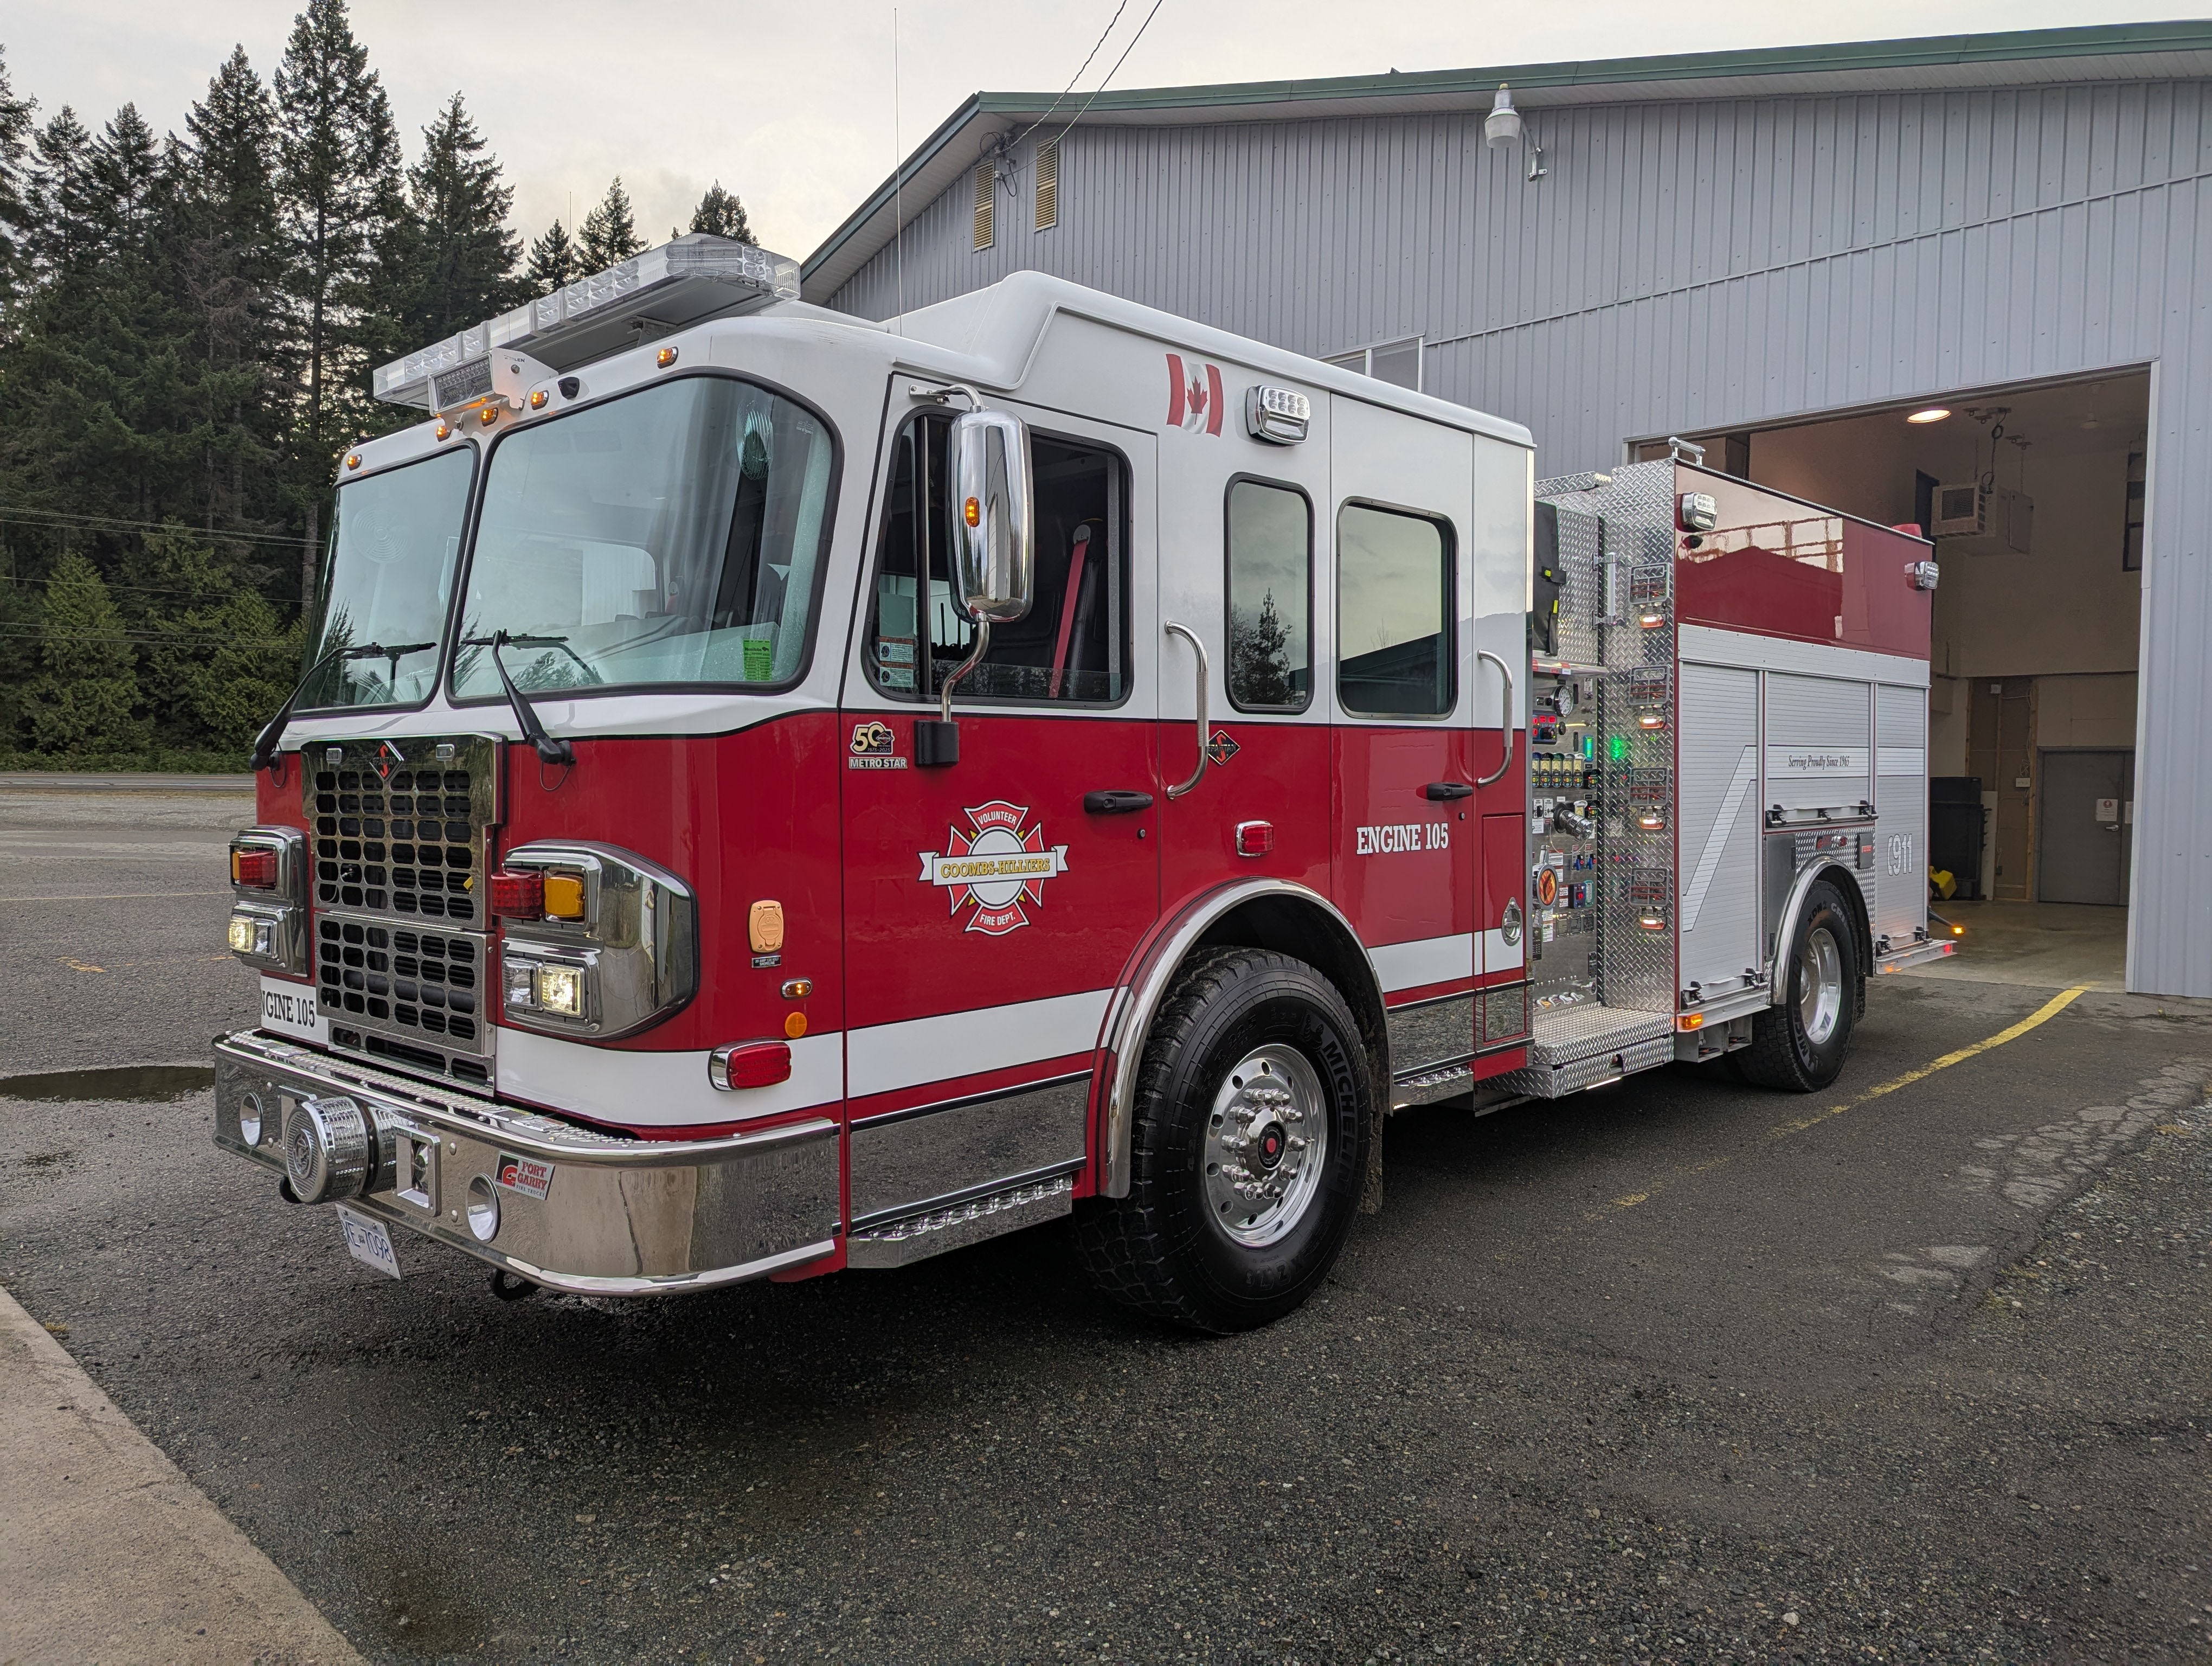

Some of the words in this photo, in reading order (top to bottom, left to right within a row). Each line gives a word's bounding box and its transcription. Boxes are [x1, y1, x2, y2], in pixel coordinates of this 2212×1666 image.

[850, 759, 882, 768] METRO
[883, 759, 906, 768] STAR
[1789, 755, 1806, 770] Serving
[1808, 755, 1825, 770] Proudly
[1827, 755, 1838, 767] Since
[978, 811, 1017, 825] VOLUNTEER
[1356, 824, 1421, 855] ENGINE
[1425, 823, 1449, 850] 105
[941, 858, 1051, 878] COOMBS-HILLIERS
[979, 913, 995, 926] FIRE
[996, 911, 1016, 925] DEPT.
[296, 997, 315, 1028] 105
[1322, 1040, 1356, 1191] MICHELIN
[522, 1161, 547, 1178] FORT
[517, 1172, 548, 1191] GARRY
[528, 1188, 545, 1197] TRUCKS
[360, 1227, 392, 1263] 7098
